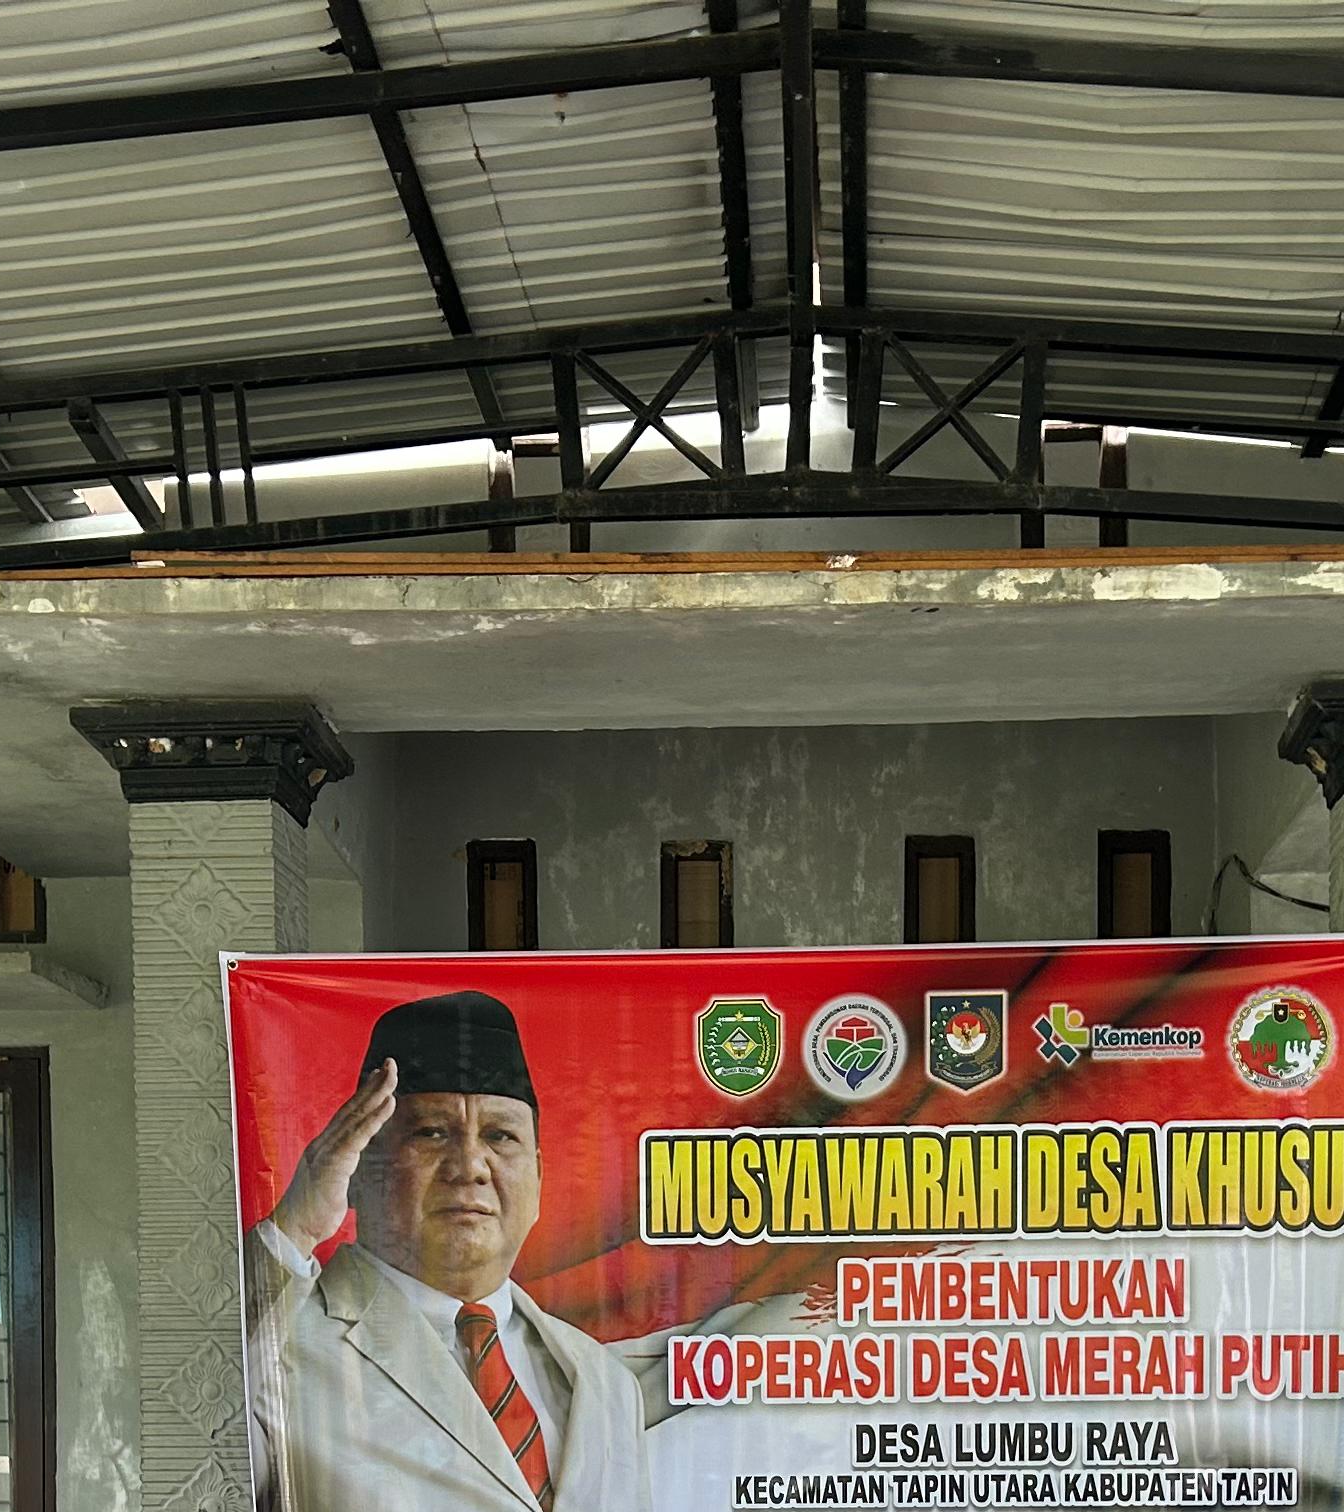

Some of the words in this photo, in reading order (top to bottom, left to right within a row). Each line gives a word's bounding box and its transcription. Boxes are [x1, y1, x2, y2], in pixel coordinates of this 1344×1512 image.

[1094, 1026, 1202, 1049] Kemenkop
[649, 1134, 1014, 1236] MUSYAWARAH
[1025, 1130, 1159, 1230] DESA
[842, 1259, 1185, 1322] PEMBENTUKAN
[673, 1338, 895, 1400] KOPERASI
[911, 1336, 1030, 1397] DESA
[1044, 1335, 1205, 1396] MERAH
[855, 1423, 944, 1464] DESA
[955, 1422, 1073, 1463] LUMBU
[1086, 1421, 1175, 1462] RAYA
[735, 1475, 885, 1504] KECAMATAN
[892, 1474, 963, 1504] TAPIN
[973, 1473, 1055, 1503] UTARA
[1064, 1472, 1213, 1502] KABUPATEN
[1221, 1471, 1293, 1501] TAPIN
